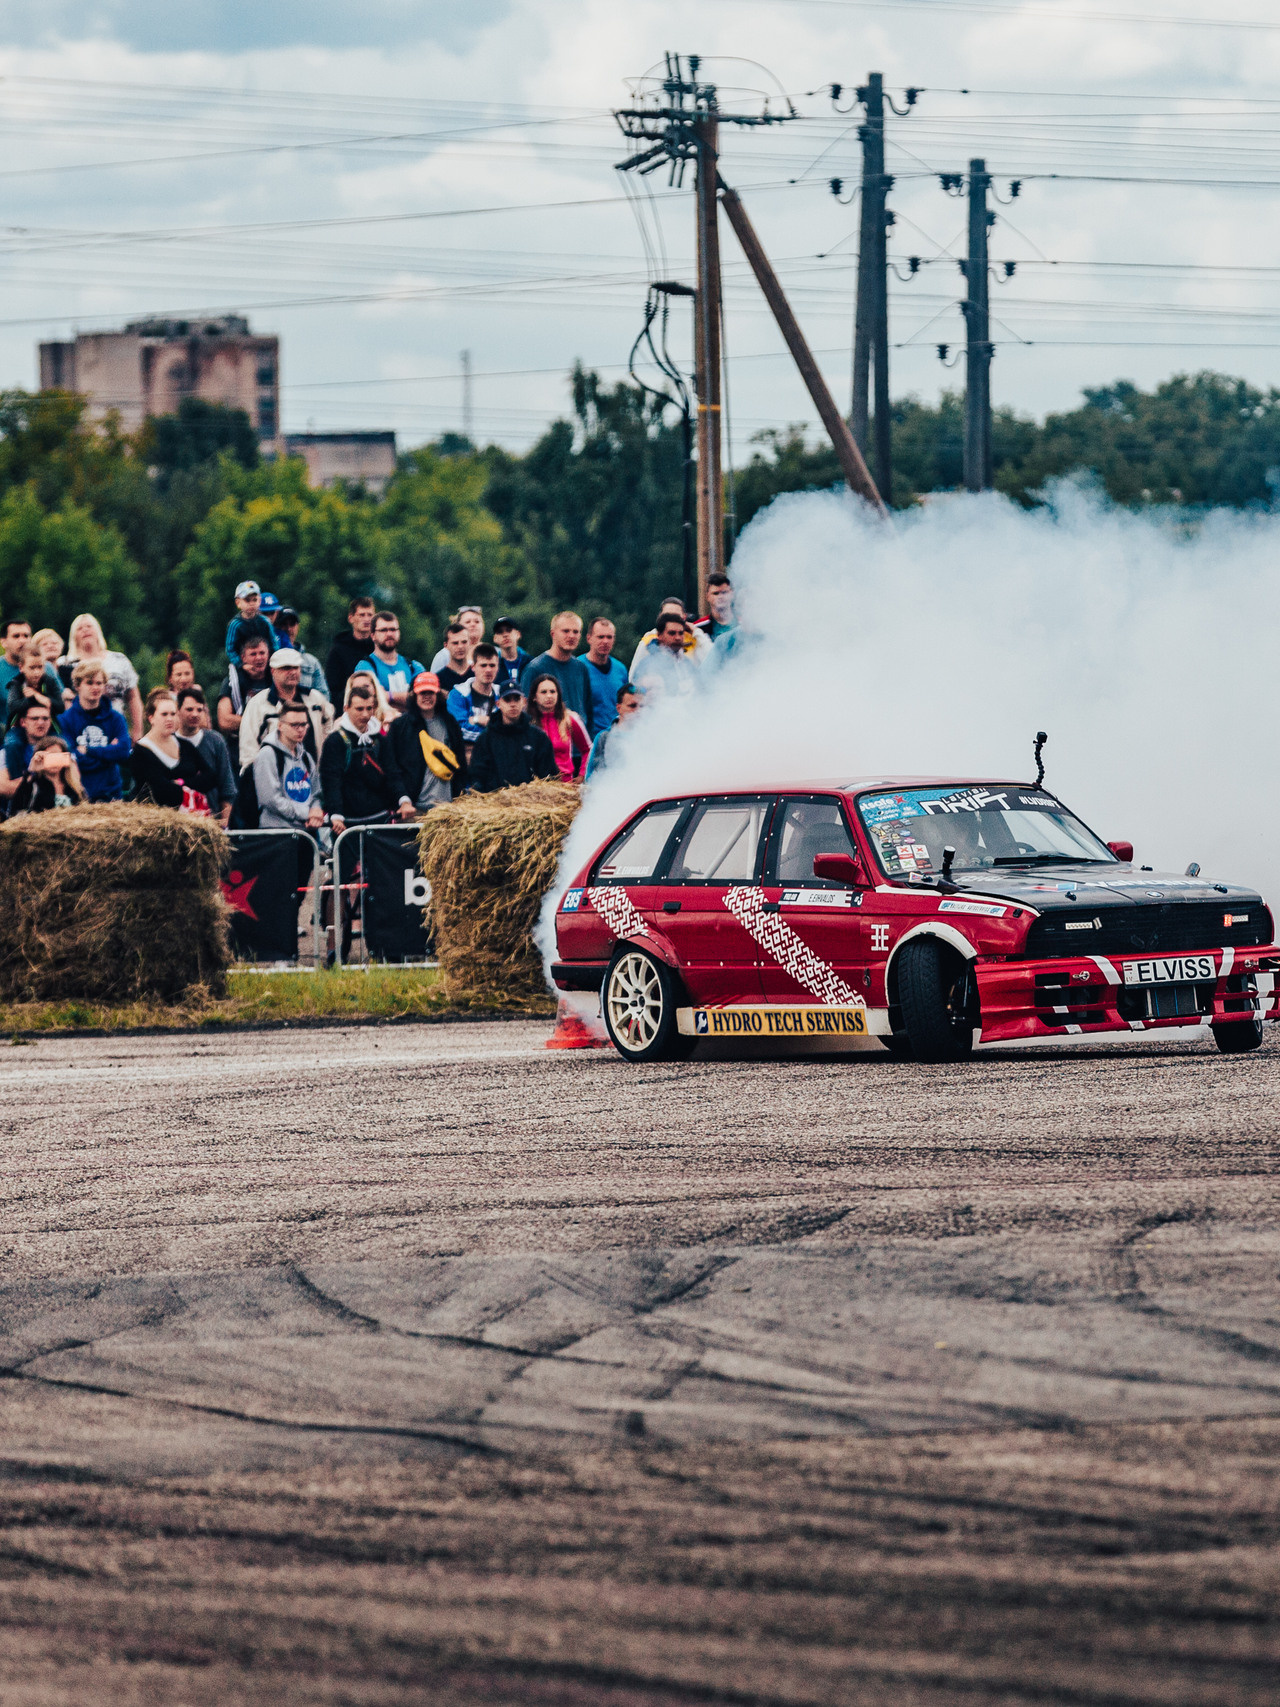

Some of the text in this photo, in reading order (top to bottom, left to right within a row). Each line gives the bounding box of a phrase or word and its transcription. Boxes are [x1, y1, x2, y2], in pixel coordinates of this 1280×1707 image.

[287, 779, 311, 791] NASA
[919, 791, 1011, 816] DRIFT
[563, 890, 583, 909] E85
[1137, 957, 1212, 982] ELVISS
[711, 1011, 865, 1032] HYDRO TECH SERVISS
